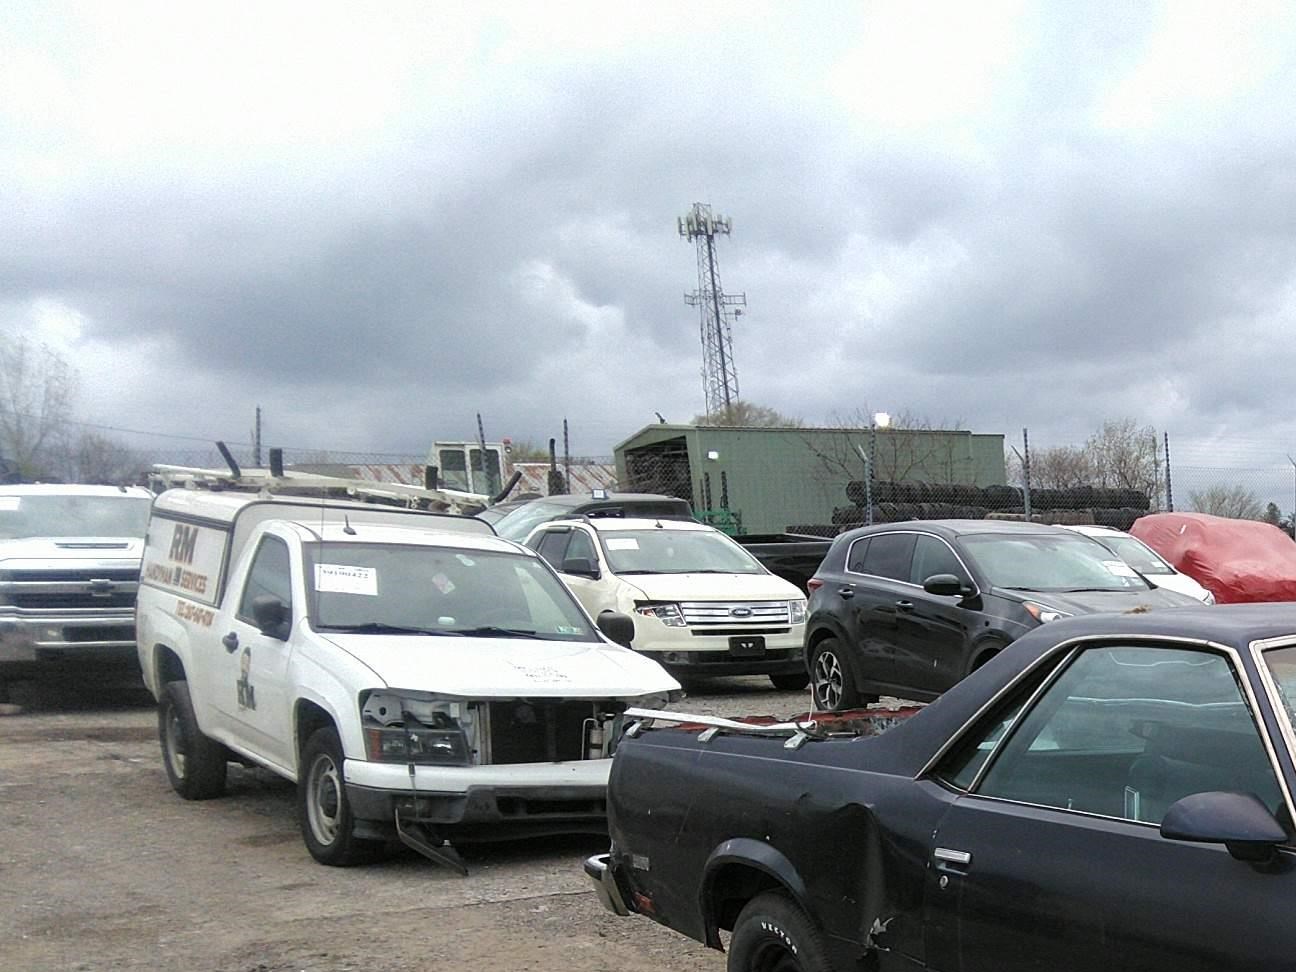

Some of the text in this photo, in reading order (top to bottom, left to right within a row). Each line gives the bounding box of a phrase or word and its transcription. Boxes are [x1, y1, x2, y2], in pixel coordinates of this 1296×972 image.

[169, 523, 198, 566] RM
[180, 569, 208, 595] SERVICES
[761, 920, 798, 955] VECTOR
